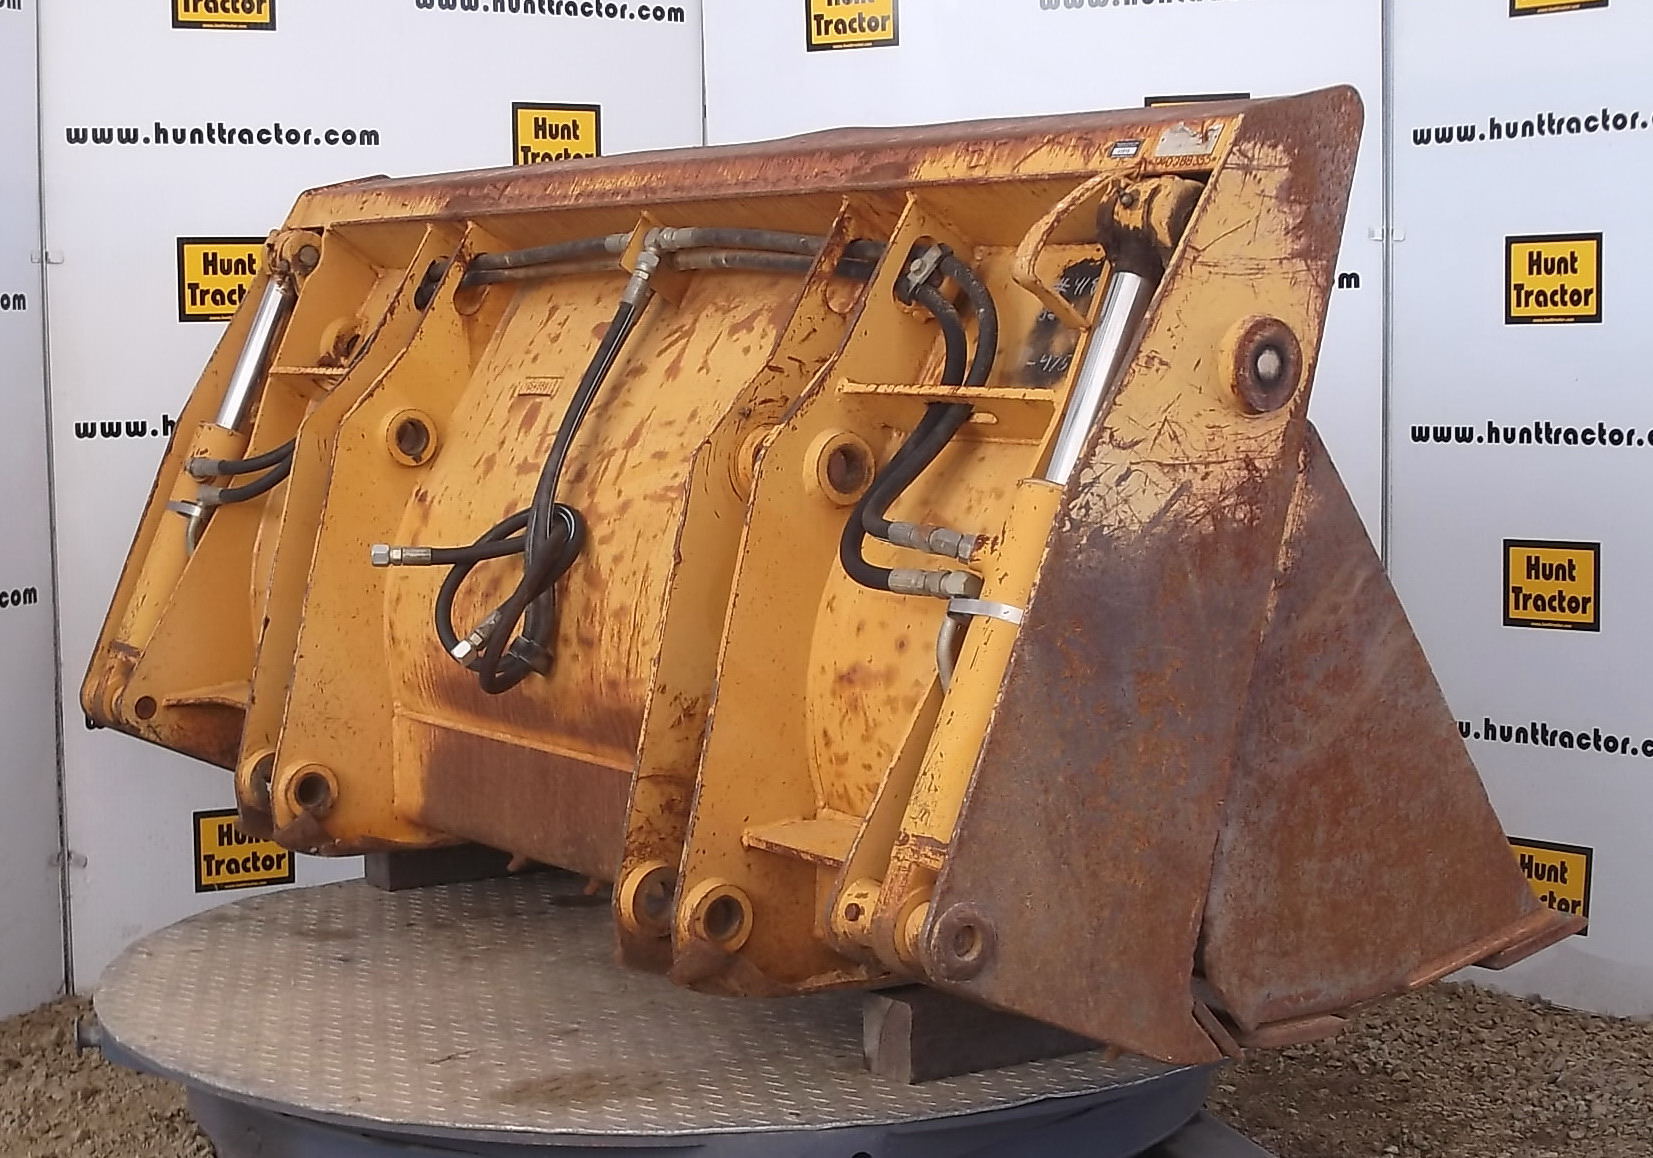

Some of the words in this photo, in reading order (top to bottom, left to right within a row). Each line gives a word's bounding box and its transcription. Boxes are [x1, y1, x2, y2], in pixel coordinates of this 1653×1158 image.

[813, 12, 890, 36] Tractor
[65, 122, 380, 145] www.hunttractor.com
[533, 116, 580, 140] Hunt
[1412, 108, 1653, 145] www.hunttractor.
[202, 252, 256, 275] Hunt
[1528, 251, 1578, 275] Hunt
[1513, 283, 1593, 308] Tractor
[1526, 555, 1576, 582] Hunt
[1511, 585, 1591, 614] Tractor
[203, 851, 287, 876] Tractor
[1520, 853, 1568, 885] Hunt
